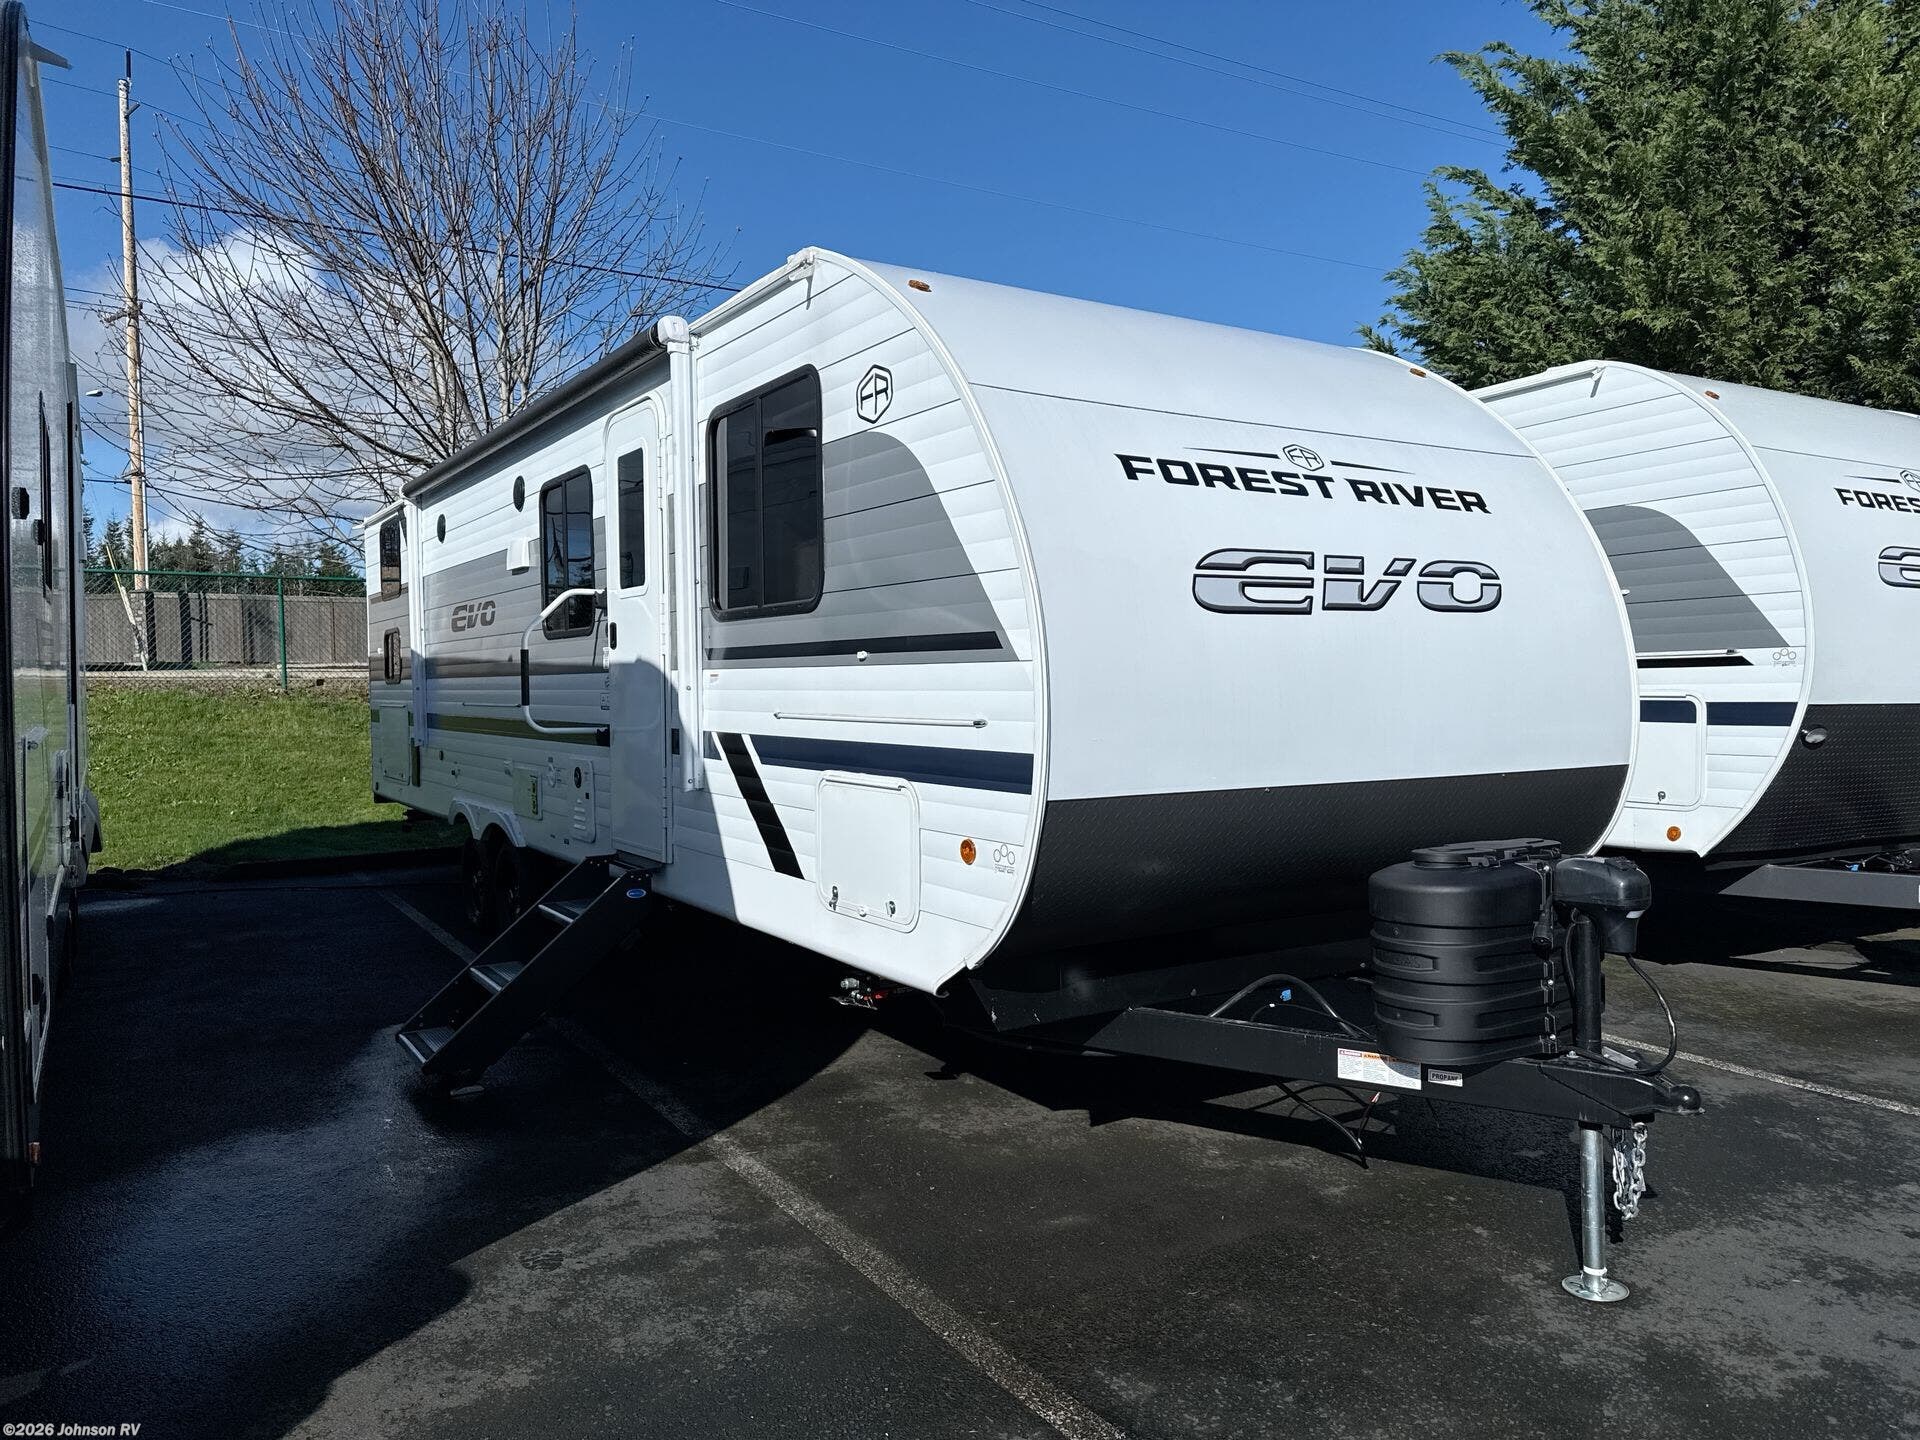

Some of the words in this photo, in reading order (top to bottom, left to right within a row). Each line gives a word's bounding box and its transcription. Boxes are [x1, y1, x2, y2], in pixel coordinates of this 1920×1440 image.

[1113, 453, 1335, 499] FOREST
[1343, 477, 1493, 514] RIVER
[1192, 547, 1502, 615] EVO
[451, 600, 496, 632] EVO
